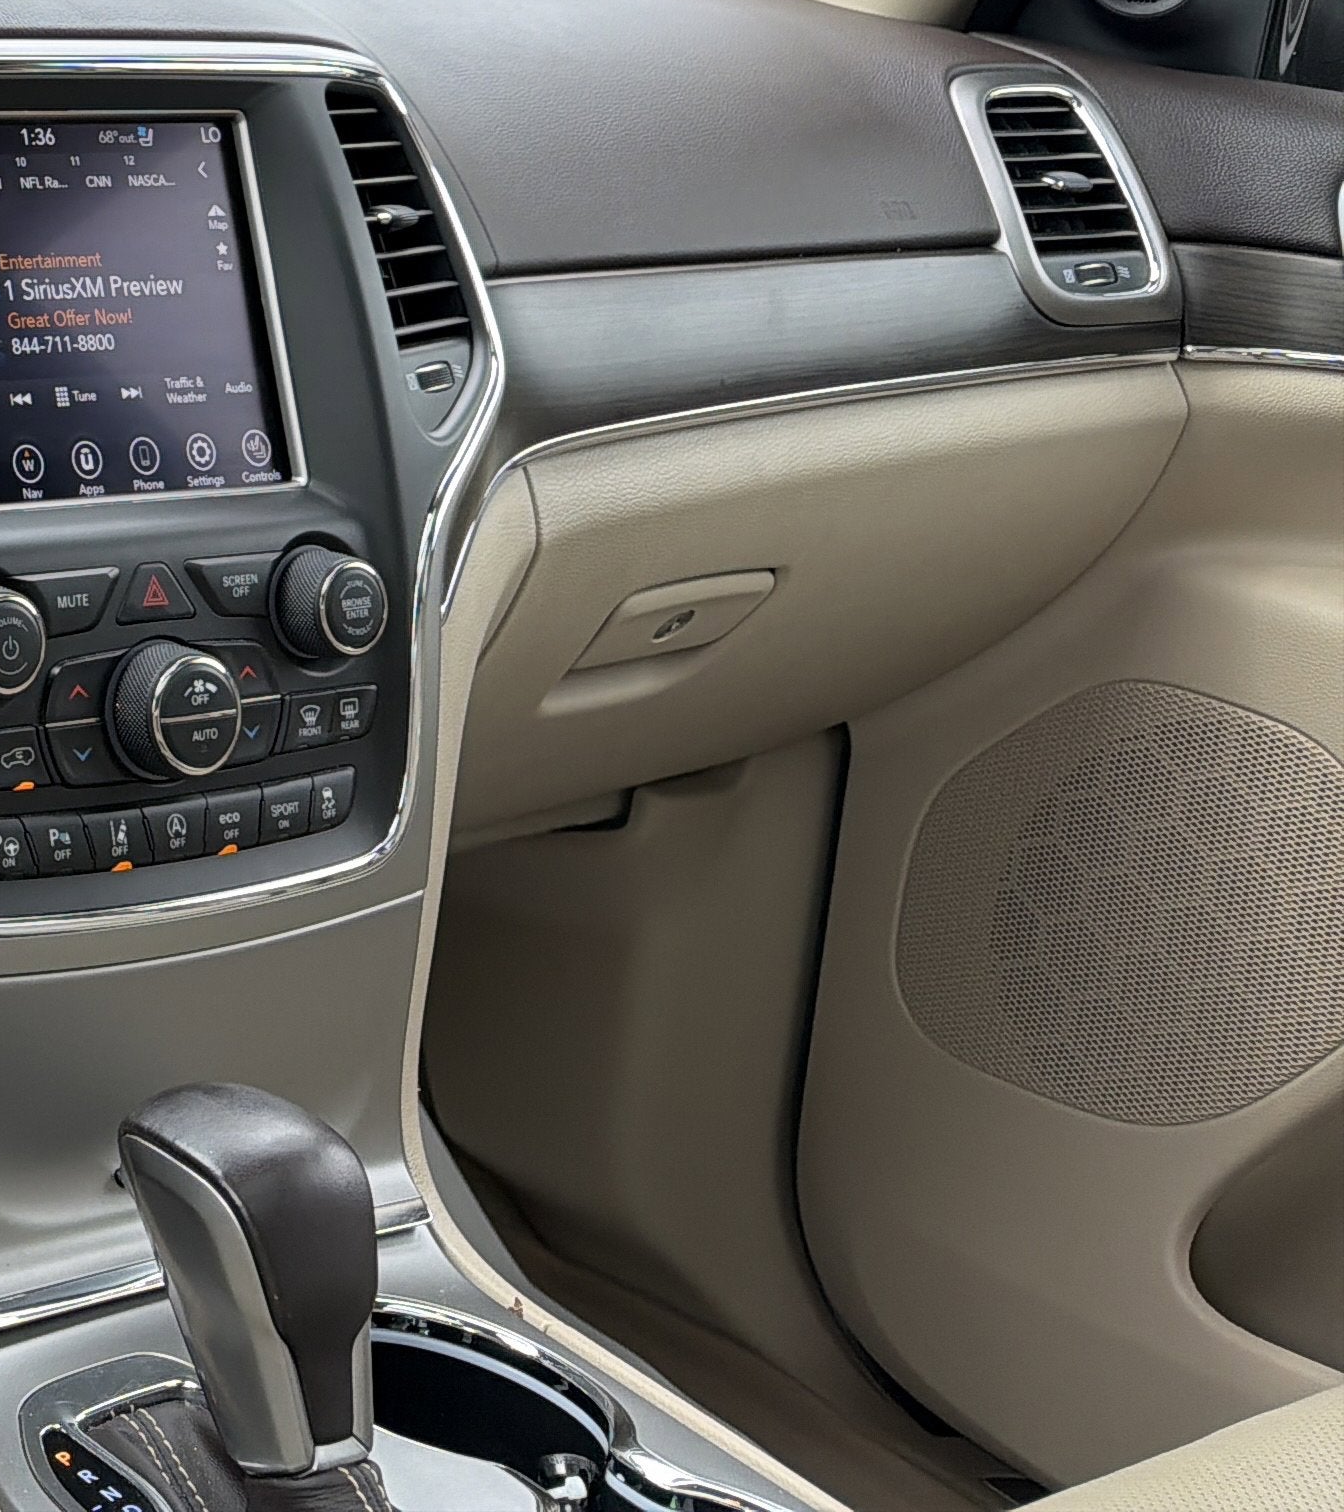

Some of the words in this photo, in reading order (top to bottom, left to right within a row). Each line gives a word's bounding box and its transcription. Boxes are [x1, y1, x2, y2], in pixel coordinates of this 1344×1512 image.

[20, 127, 55, 146] 1:36
[200, 126, 221, 144] LO
[15, 156, 27, 167] 10
[69, 155, 81, 166] 11
[122, 155, 136, 166] 12
[19, 177, 43, 189] NFL
[85, 175, 112, 188] CNN
[208, 220, 228, 231] Map
[0, 251, 103, 271] Entertainment
[217, 260, 233, 271] Fav
[3, 279, 14, 301] 1
[22, 276, 105, 301] SiriusXM
[109, 274, 183, 297] Preview
[8, 311, 51, 330] Great
[54, 309, 90, 328] Offer
[94, 307, 133, 325] Now!
[12, 333, 115, 355] 844-711-8800
[164, 376, 194, 389] Traffic
[195, 375, 205, 388] &
[224, 381, 253, 394] Audio
[71, 390, 97, 402] Tune
[165, 391, 207, 404] Weather
[21, 458, 35, 472] W
[186, 474, 226, 488] Settings
[241, 470, 282, 483] Controls
[79, 483, 105, 497] Apps
[132, 478, 165, 492] Phone
[22, 487, 43, 500] Nav
[222, 573, 259, 587] SCREEN
[232, 587, 251, 598] OFF
[56, 593, 90, 608] MUTE
[341, 595, 372, 608] BROWSE
[345, 608, 370, 620] ENTER
[190, 694, 210, 706] OFF
[298, 725, 323, 737] FRONT
[340, 719, 360, 731] REAR
[192, 727, 219, 742] AUTO
[270, 801, 300, 818] SPORT
[322, 807, 337, 820] OFF
[218, 811, 241, 825] eco
[278, 819, 291, 830] ON
[171, 817, 182, 833] A
[49, 828, 60, 848] P
[223, 828, 240, 840] OFF
[169, 837, 187, 849] OFF
[54, 849, 72, 862] OFF
[111, 844, 129, 858] OFF
[2, 857, 16, 868] ON
[54, 1450, 72, 1467] P
[76, 1469, 100, 1484] R
[99, 1485, 123, 1503] N
